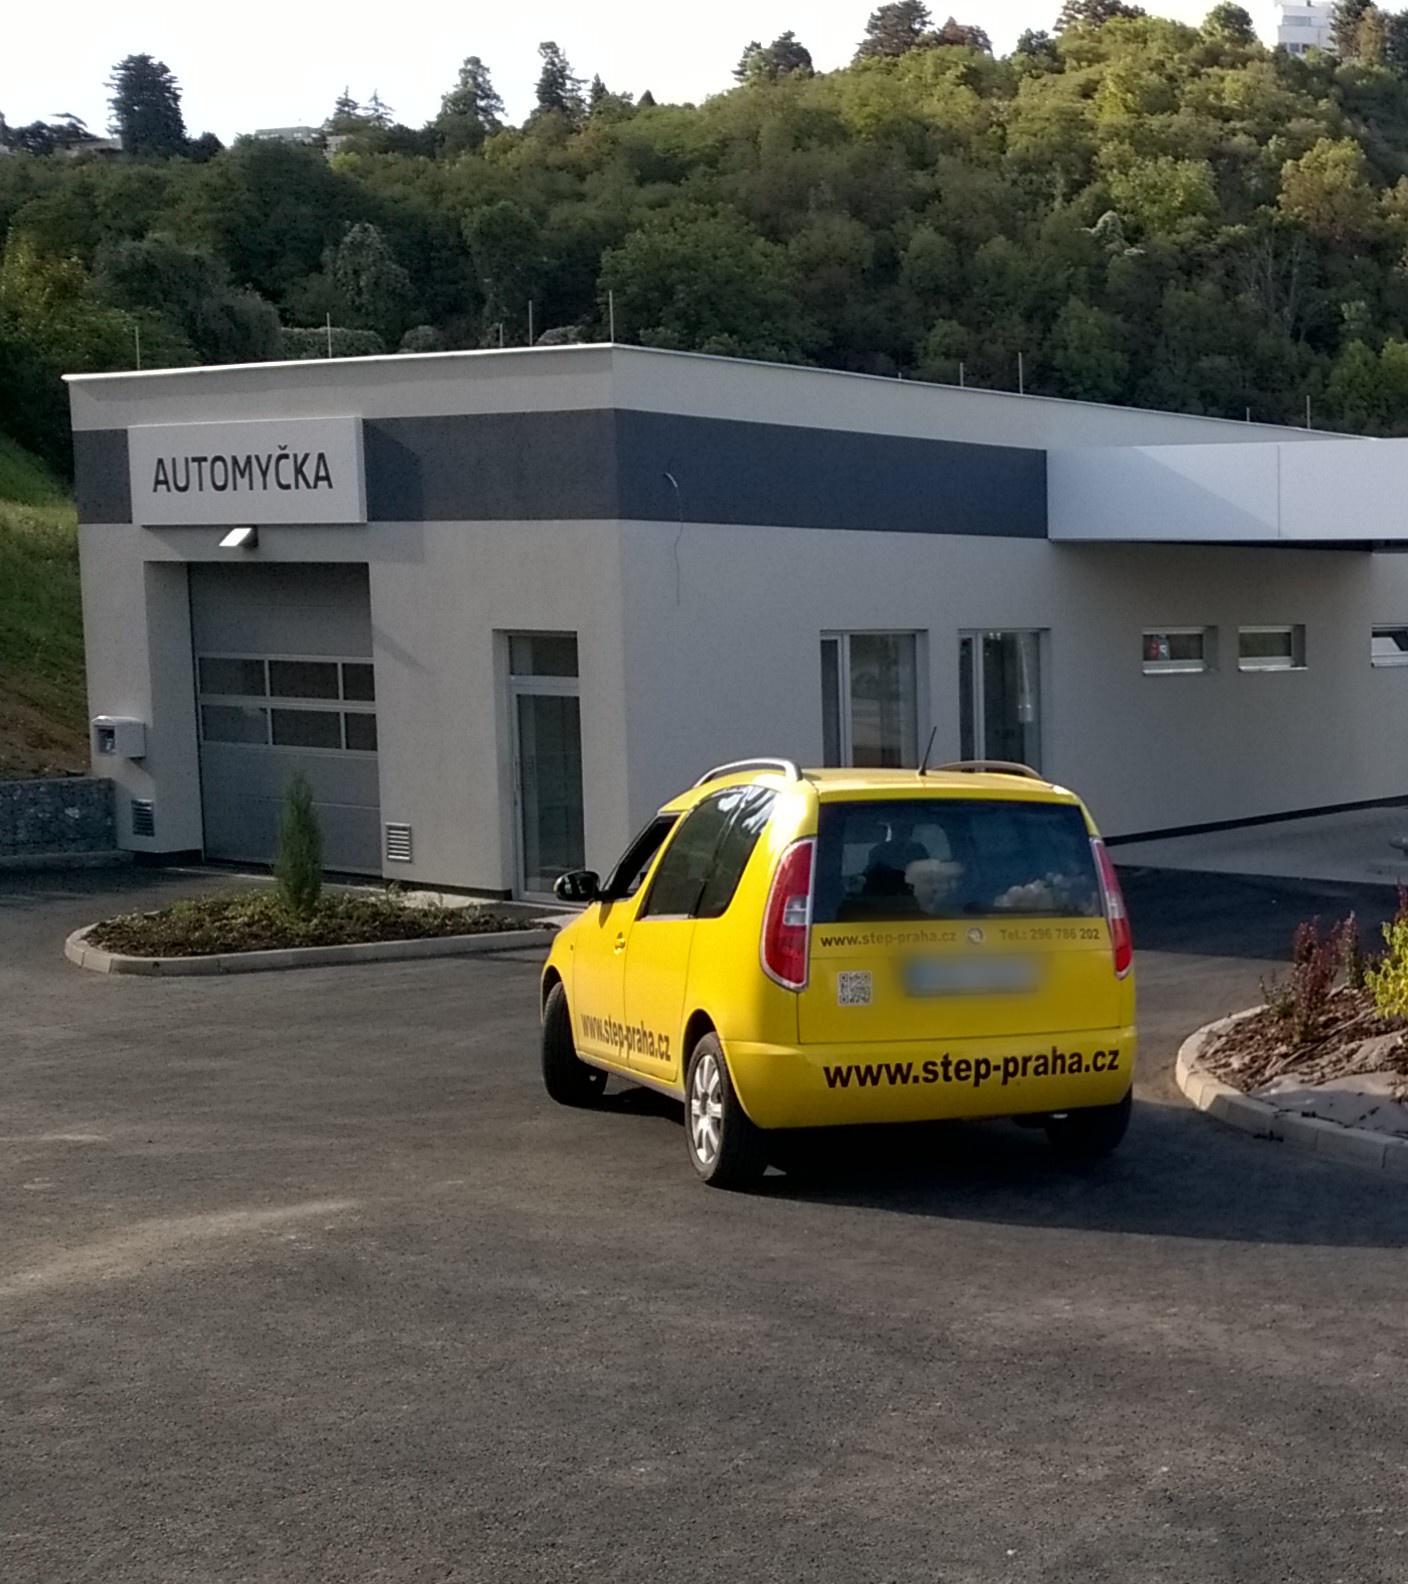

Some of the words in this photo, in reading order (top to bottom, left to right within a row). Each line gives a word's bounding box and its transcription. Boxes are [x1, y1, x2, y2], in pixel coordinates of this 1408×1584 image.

[152, 444, 333, 493] AUTOMYČKA
[820, 931, 957, 948] www.step-praha.cz
[1030, 927, 1053, 941] 296
[1055, 927, 1078, 940] 786
[1079, 926, 1100, 940] 202
[581, 1013, 671, 1062] www.step-praha.cz
[823, 1046, 1120, 1088] www.step-praha.cz
